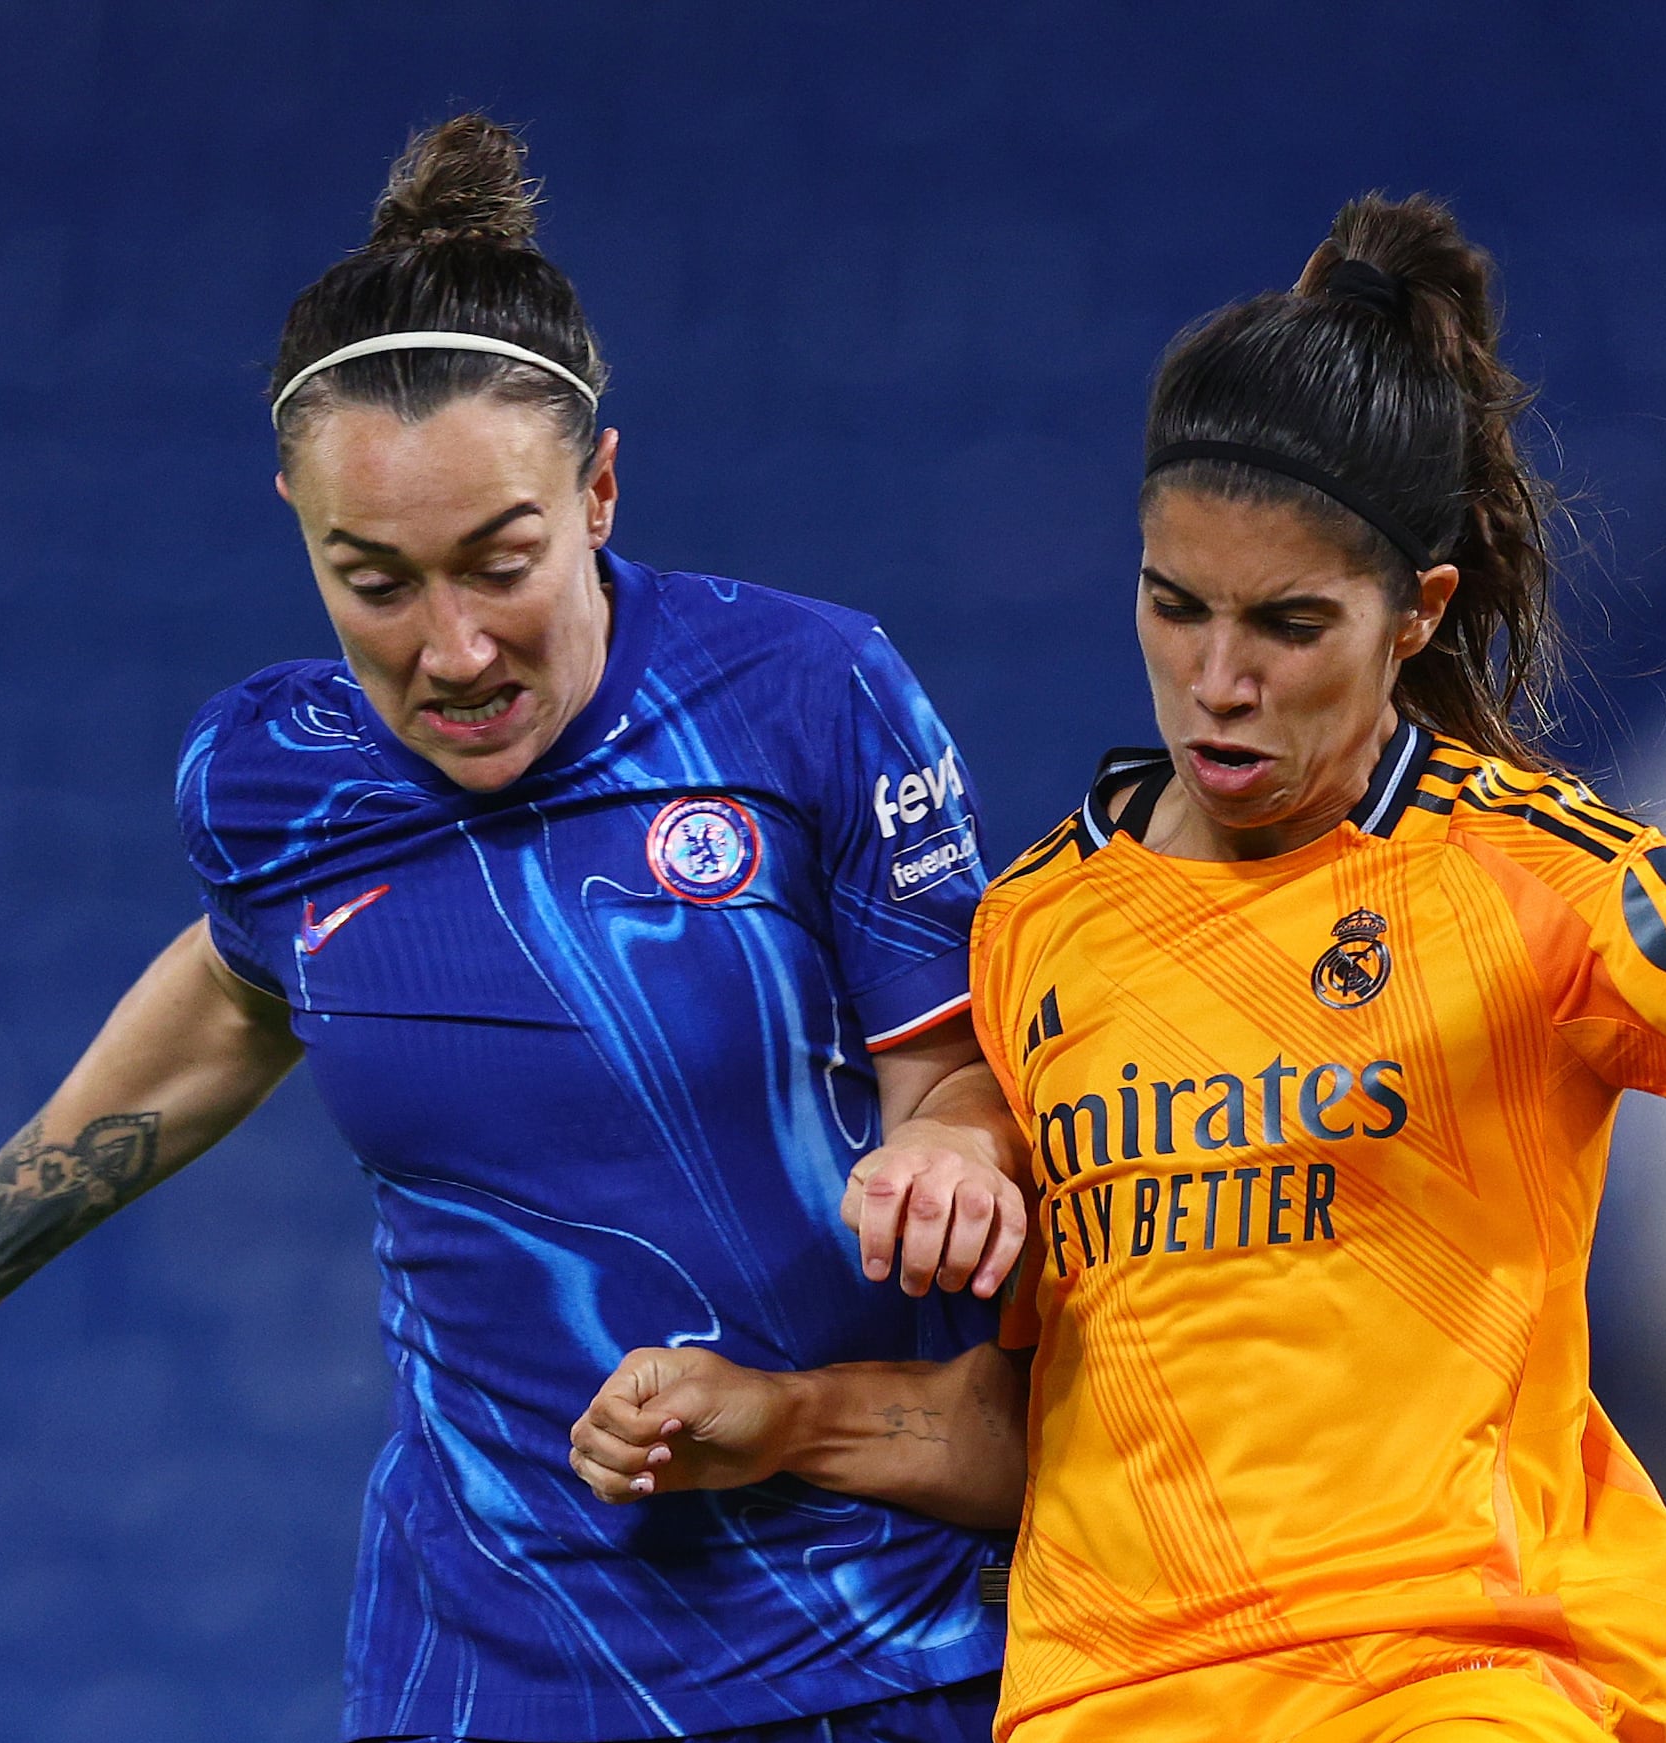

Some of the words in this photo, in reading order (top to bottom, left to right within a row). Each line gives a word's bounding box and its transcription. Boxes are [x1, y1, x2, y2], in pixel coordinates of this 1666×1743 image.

[1037, 1053, 1408, 1190] mirates
[1050, 1182, 1113, 1278] FLY
[1131, 1163, 1336, 1257] BETTER
